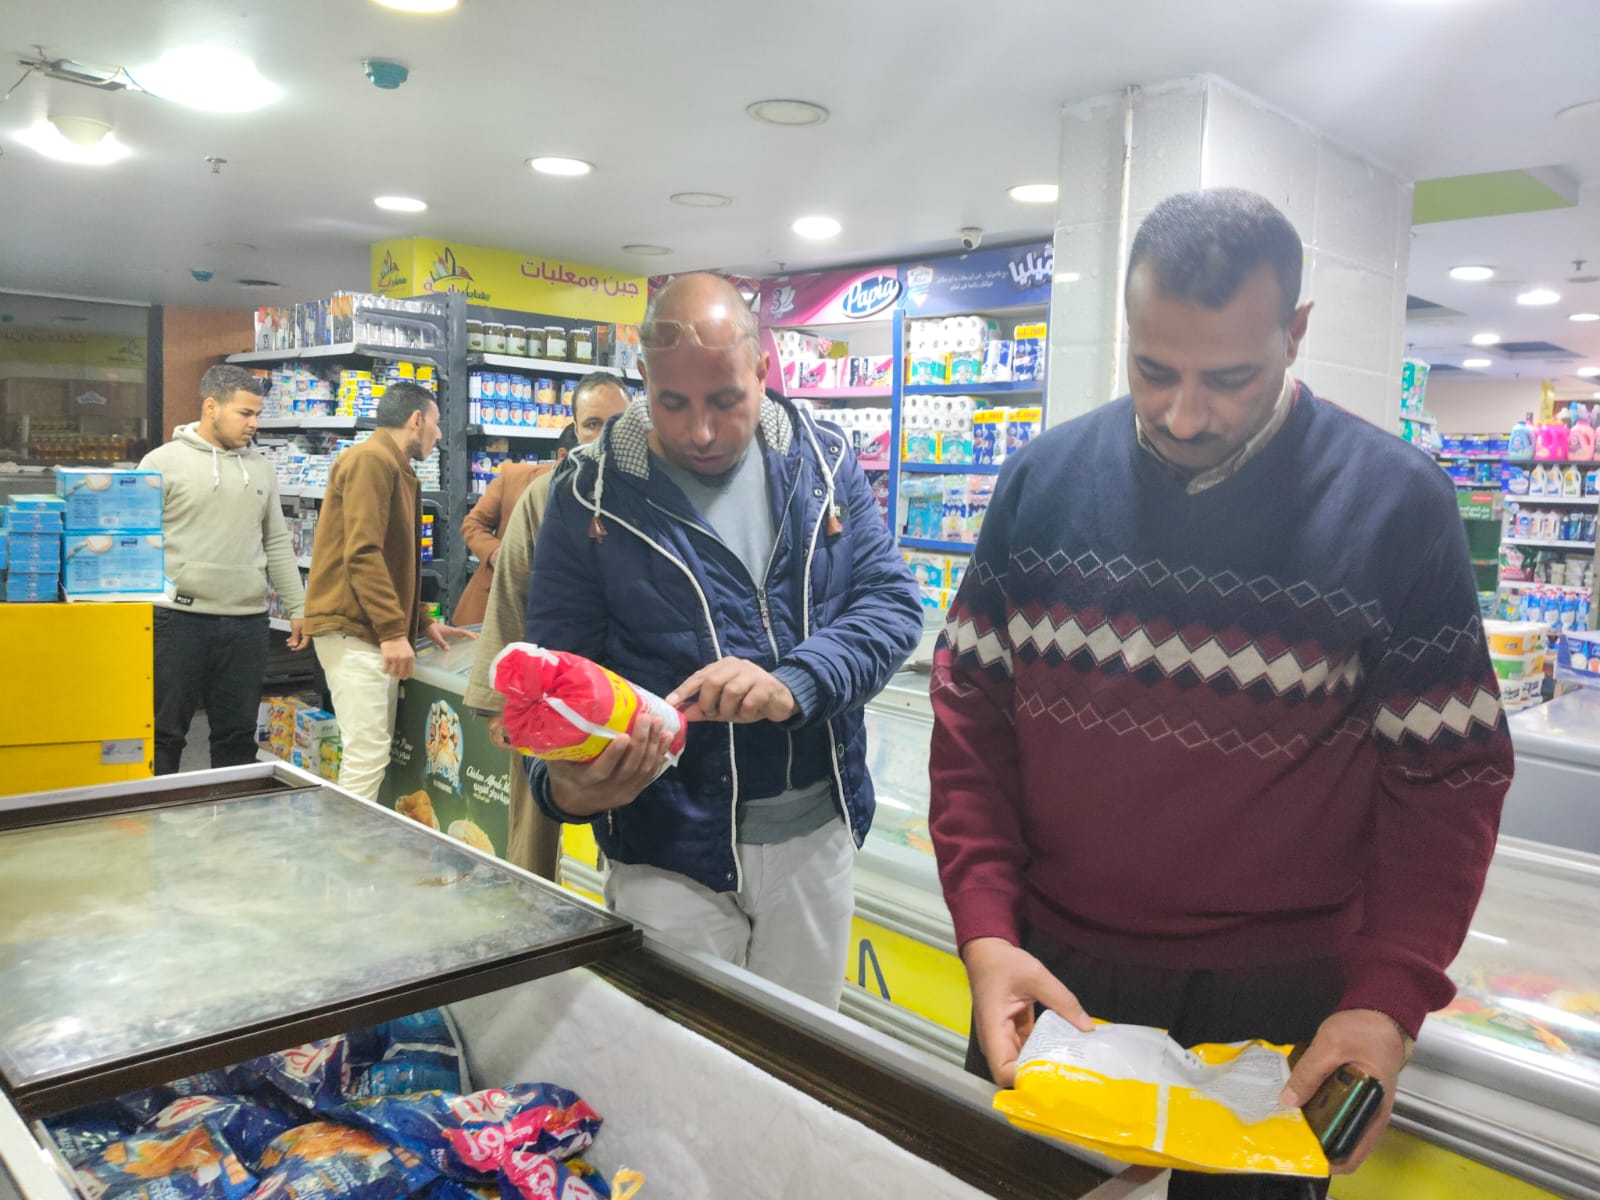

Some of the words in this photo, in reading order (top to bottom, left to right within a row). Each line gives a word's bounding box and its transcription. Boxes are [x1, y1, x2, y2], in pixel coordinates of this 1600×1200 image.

[521, 260, 599, 292] ومعلبات
[604, 275, 638, 298] جبن
[845, 275, 899, 315] Papia
